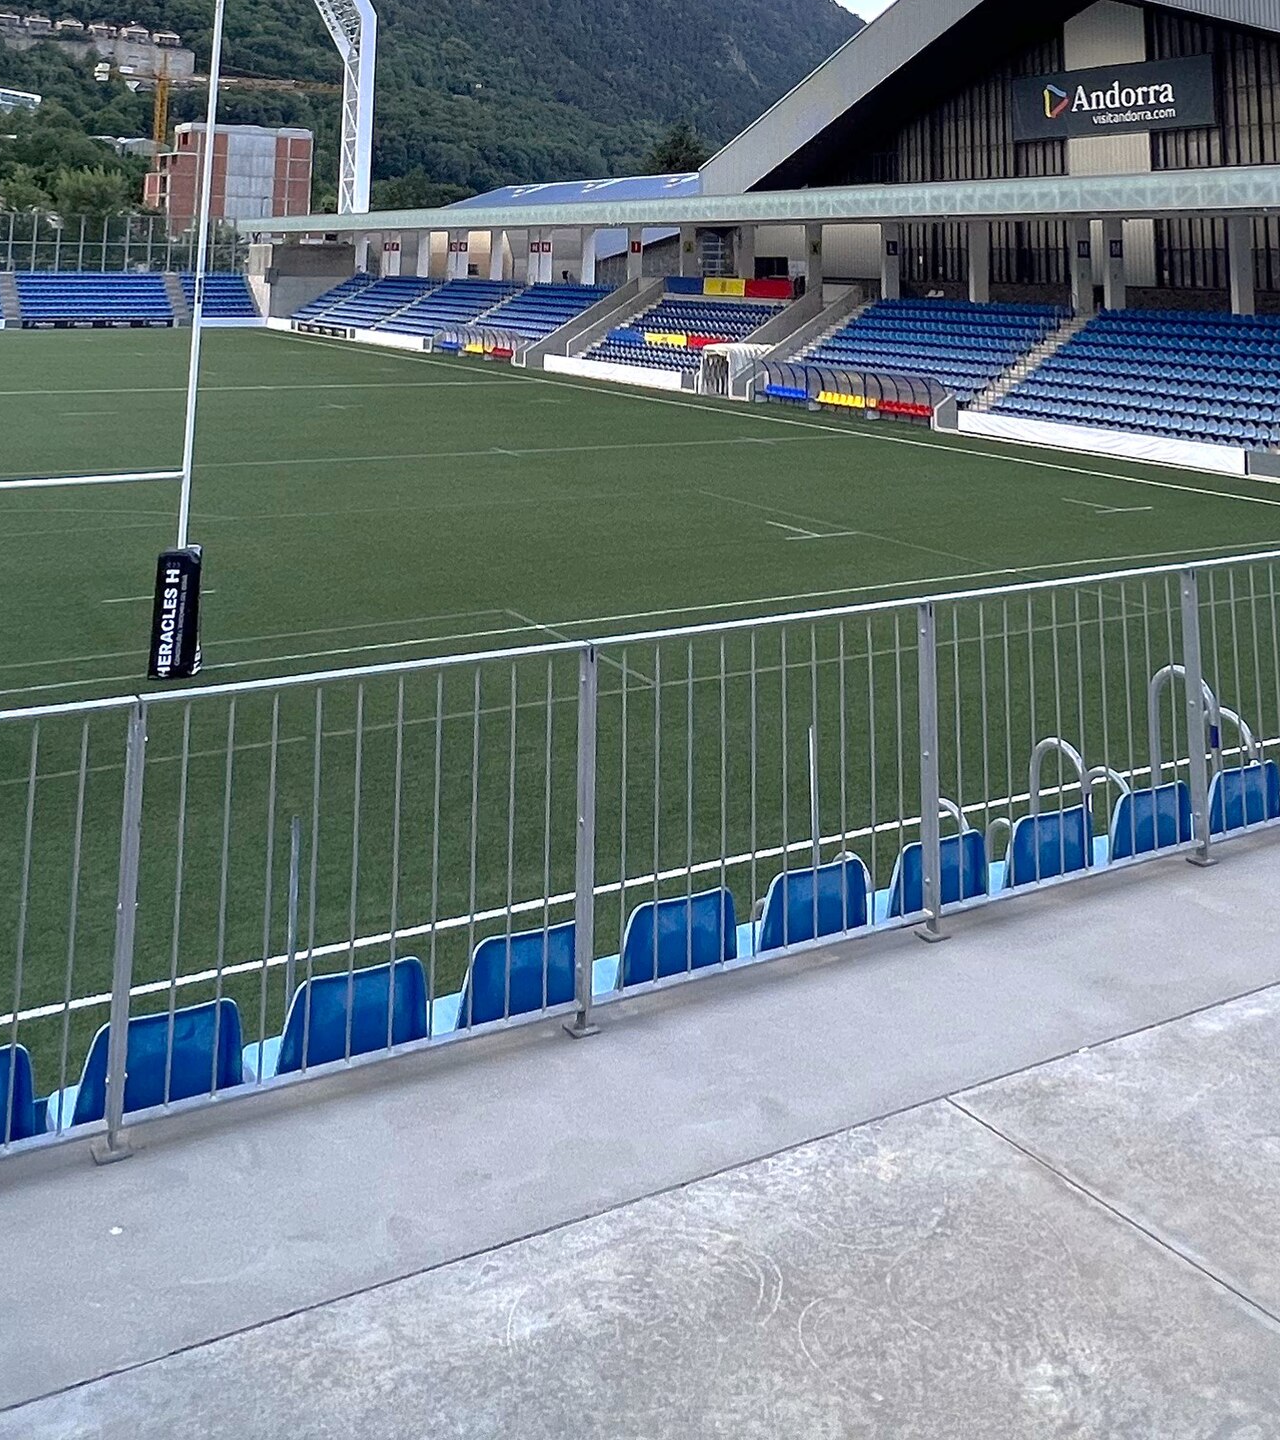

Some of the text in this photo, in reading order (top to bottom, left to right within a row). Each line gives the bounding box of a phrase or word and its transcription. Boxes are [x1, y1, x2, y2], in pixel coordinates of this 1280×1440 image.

[1071, 80, 1175, 112] Andorra
[1092, 107, 1176, 124] visitandorra.com
[157, 587, 178, 678] HERACLES
